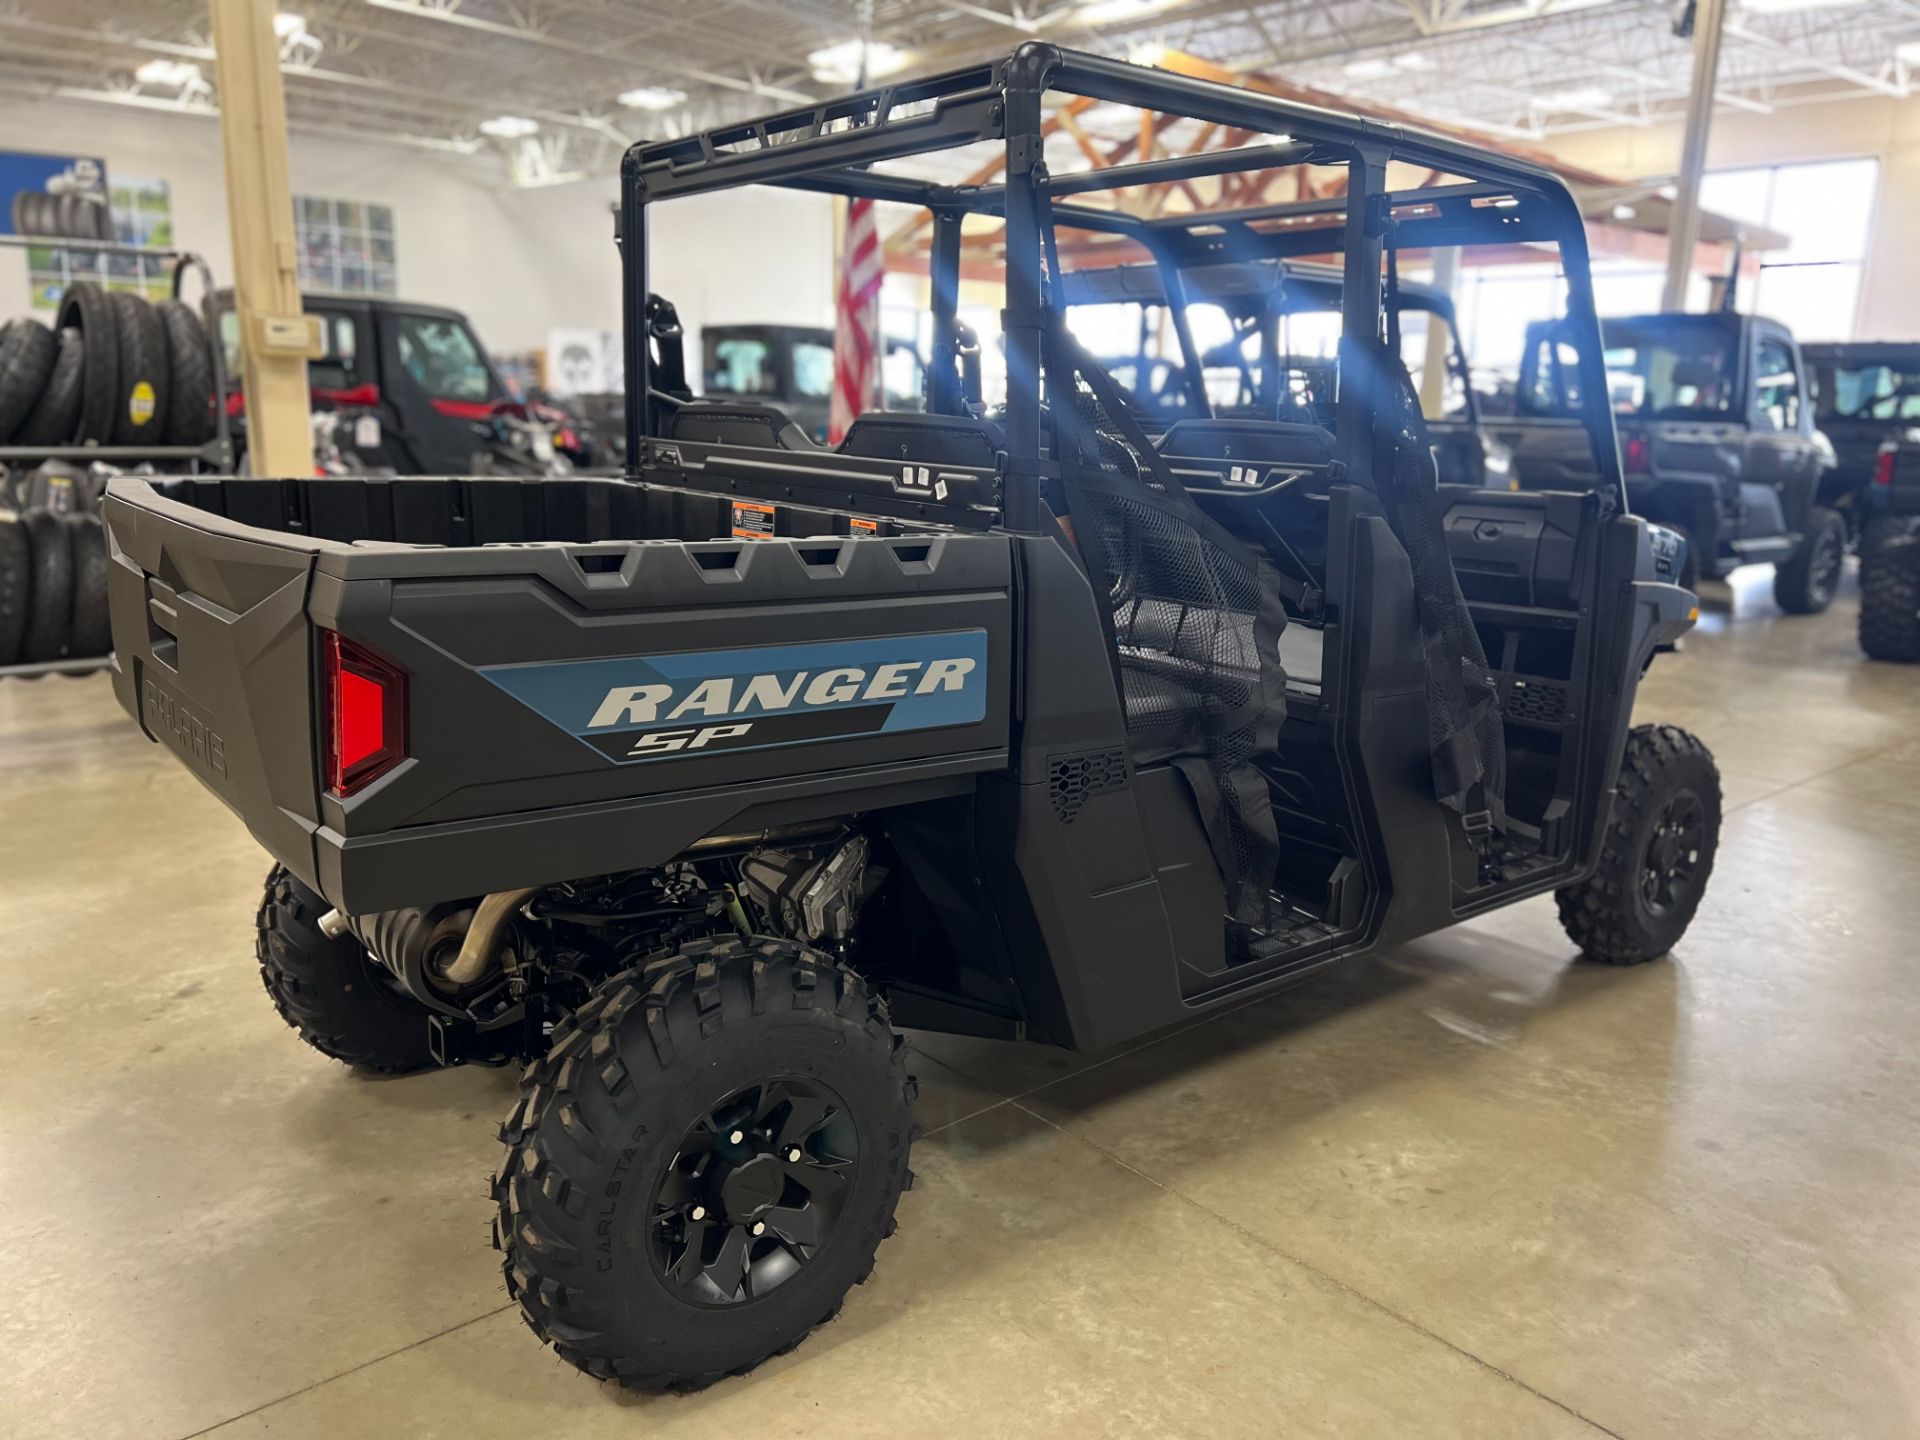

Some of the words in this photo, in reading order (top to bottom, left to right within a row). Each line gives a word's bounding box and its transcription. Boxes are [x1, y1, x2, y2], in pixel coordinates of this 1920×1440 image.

[587, 657, 976, 728] RANGER
[626, 723, 753, 756] SP
[596, 1124, 648, 1272] CARLSTAR
